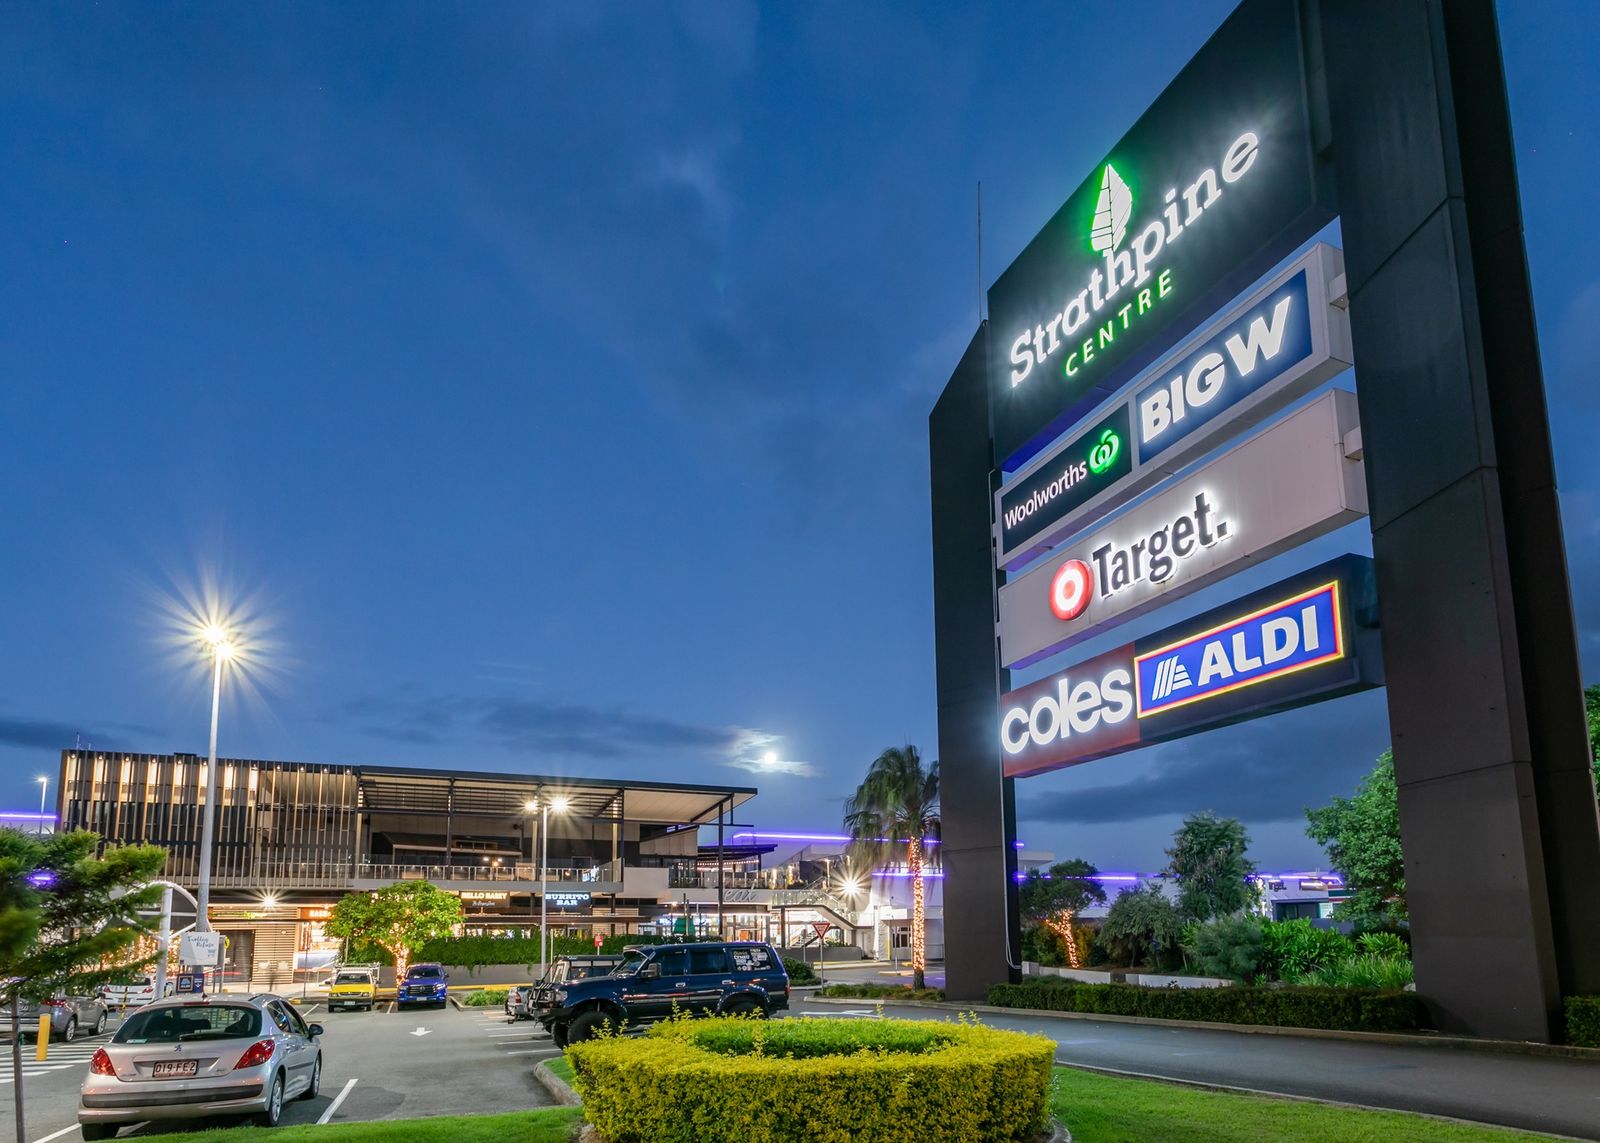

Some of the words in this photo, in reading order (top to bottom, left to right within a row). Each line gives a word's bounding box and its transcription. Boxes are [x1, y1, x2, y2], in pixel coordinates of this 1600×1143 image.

[1010, 132, 1259, 388] Strathpine
[1065, 269, 1173, 377] CENTRE
[1004, 459, 1088, 530] Woolworths
[1197, 604, 1320, 687] ALDI
[1001, 668, 1134, 755] coles
[461, 892, 485, 900] HELLO
[723, 878, 757, 901] eat
